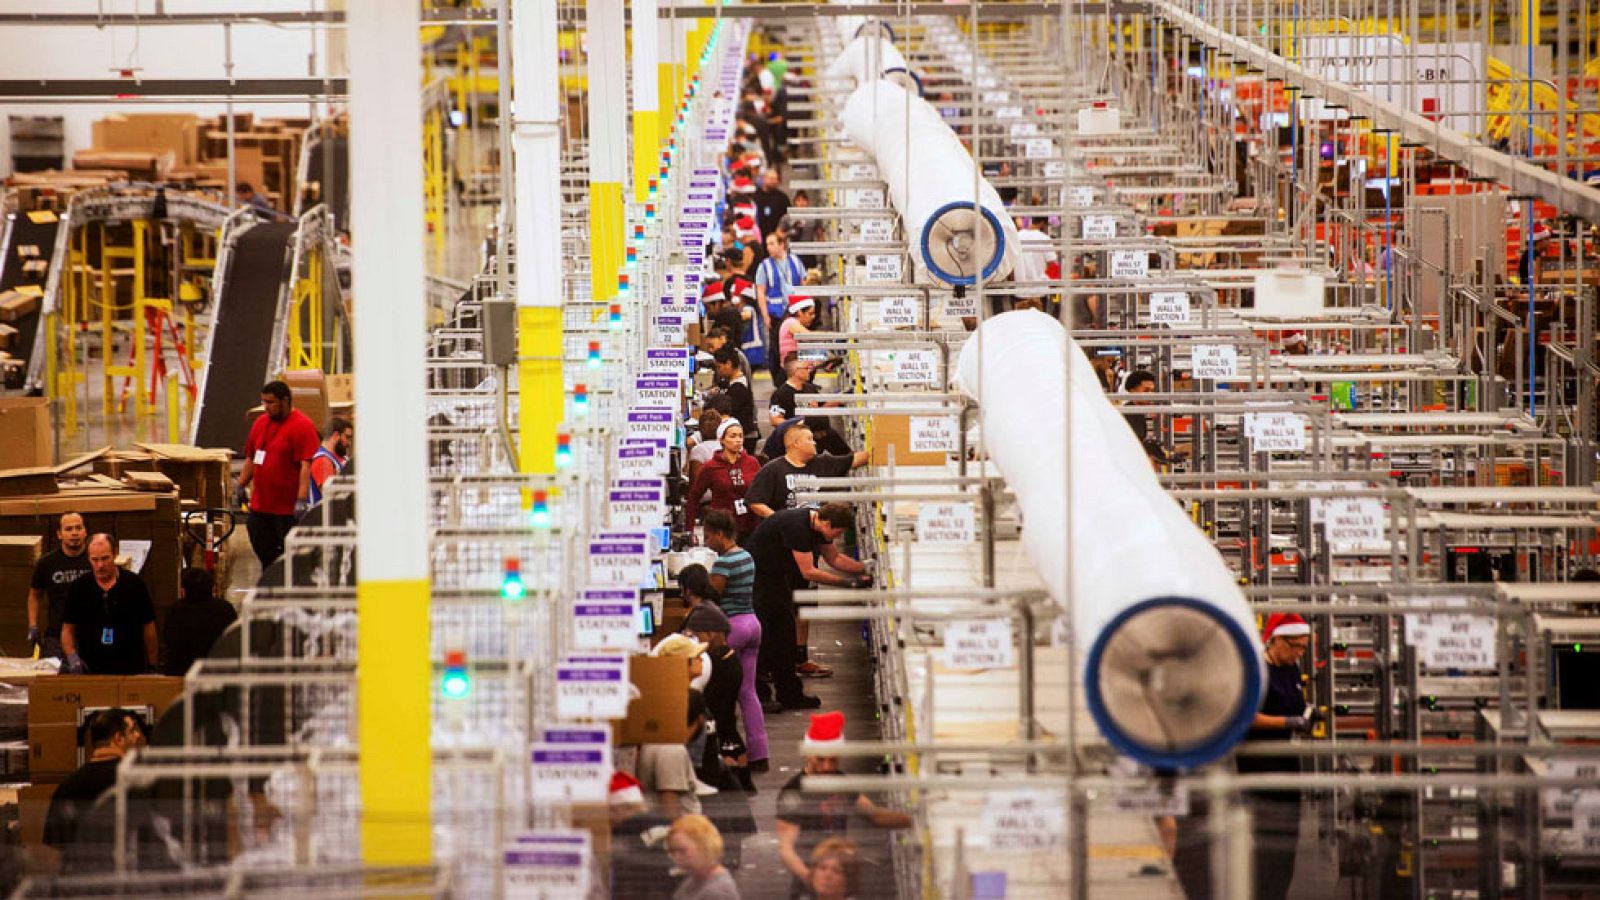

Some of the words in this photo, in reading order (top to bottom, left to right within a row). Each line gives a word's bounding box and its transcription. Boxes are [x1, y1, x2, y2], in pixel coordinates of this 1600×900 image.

[897, 372, 926, 380] SECTION
[639, 390, 676, 398] STATION
[630, 424, 670, 432] STATION
[915, 441, 946, 449] SECTION
[621, 460, 652, 468] STATION
[614, 504, 657, 514] STATION
[1346, 503, 1361, 512] AFE
[928, 520, 952, 528] WALL
[1336, 516, 1360, 524] WALL
[924, 531, 961, 540] SECTION
[1332, 529, 1369, 537] SECTION
[594, 558, 641, 567] STATION
[580, 620, 630, 628] STATION
[1452, 623, 1469, 633] AFE
[957, 639, 984, 649] WALL
[1438, 638, 1466, 648] WALL
[1433, 652, 1477, 664] SECTION
[562, 686, 618, 697] STATION
